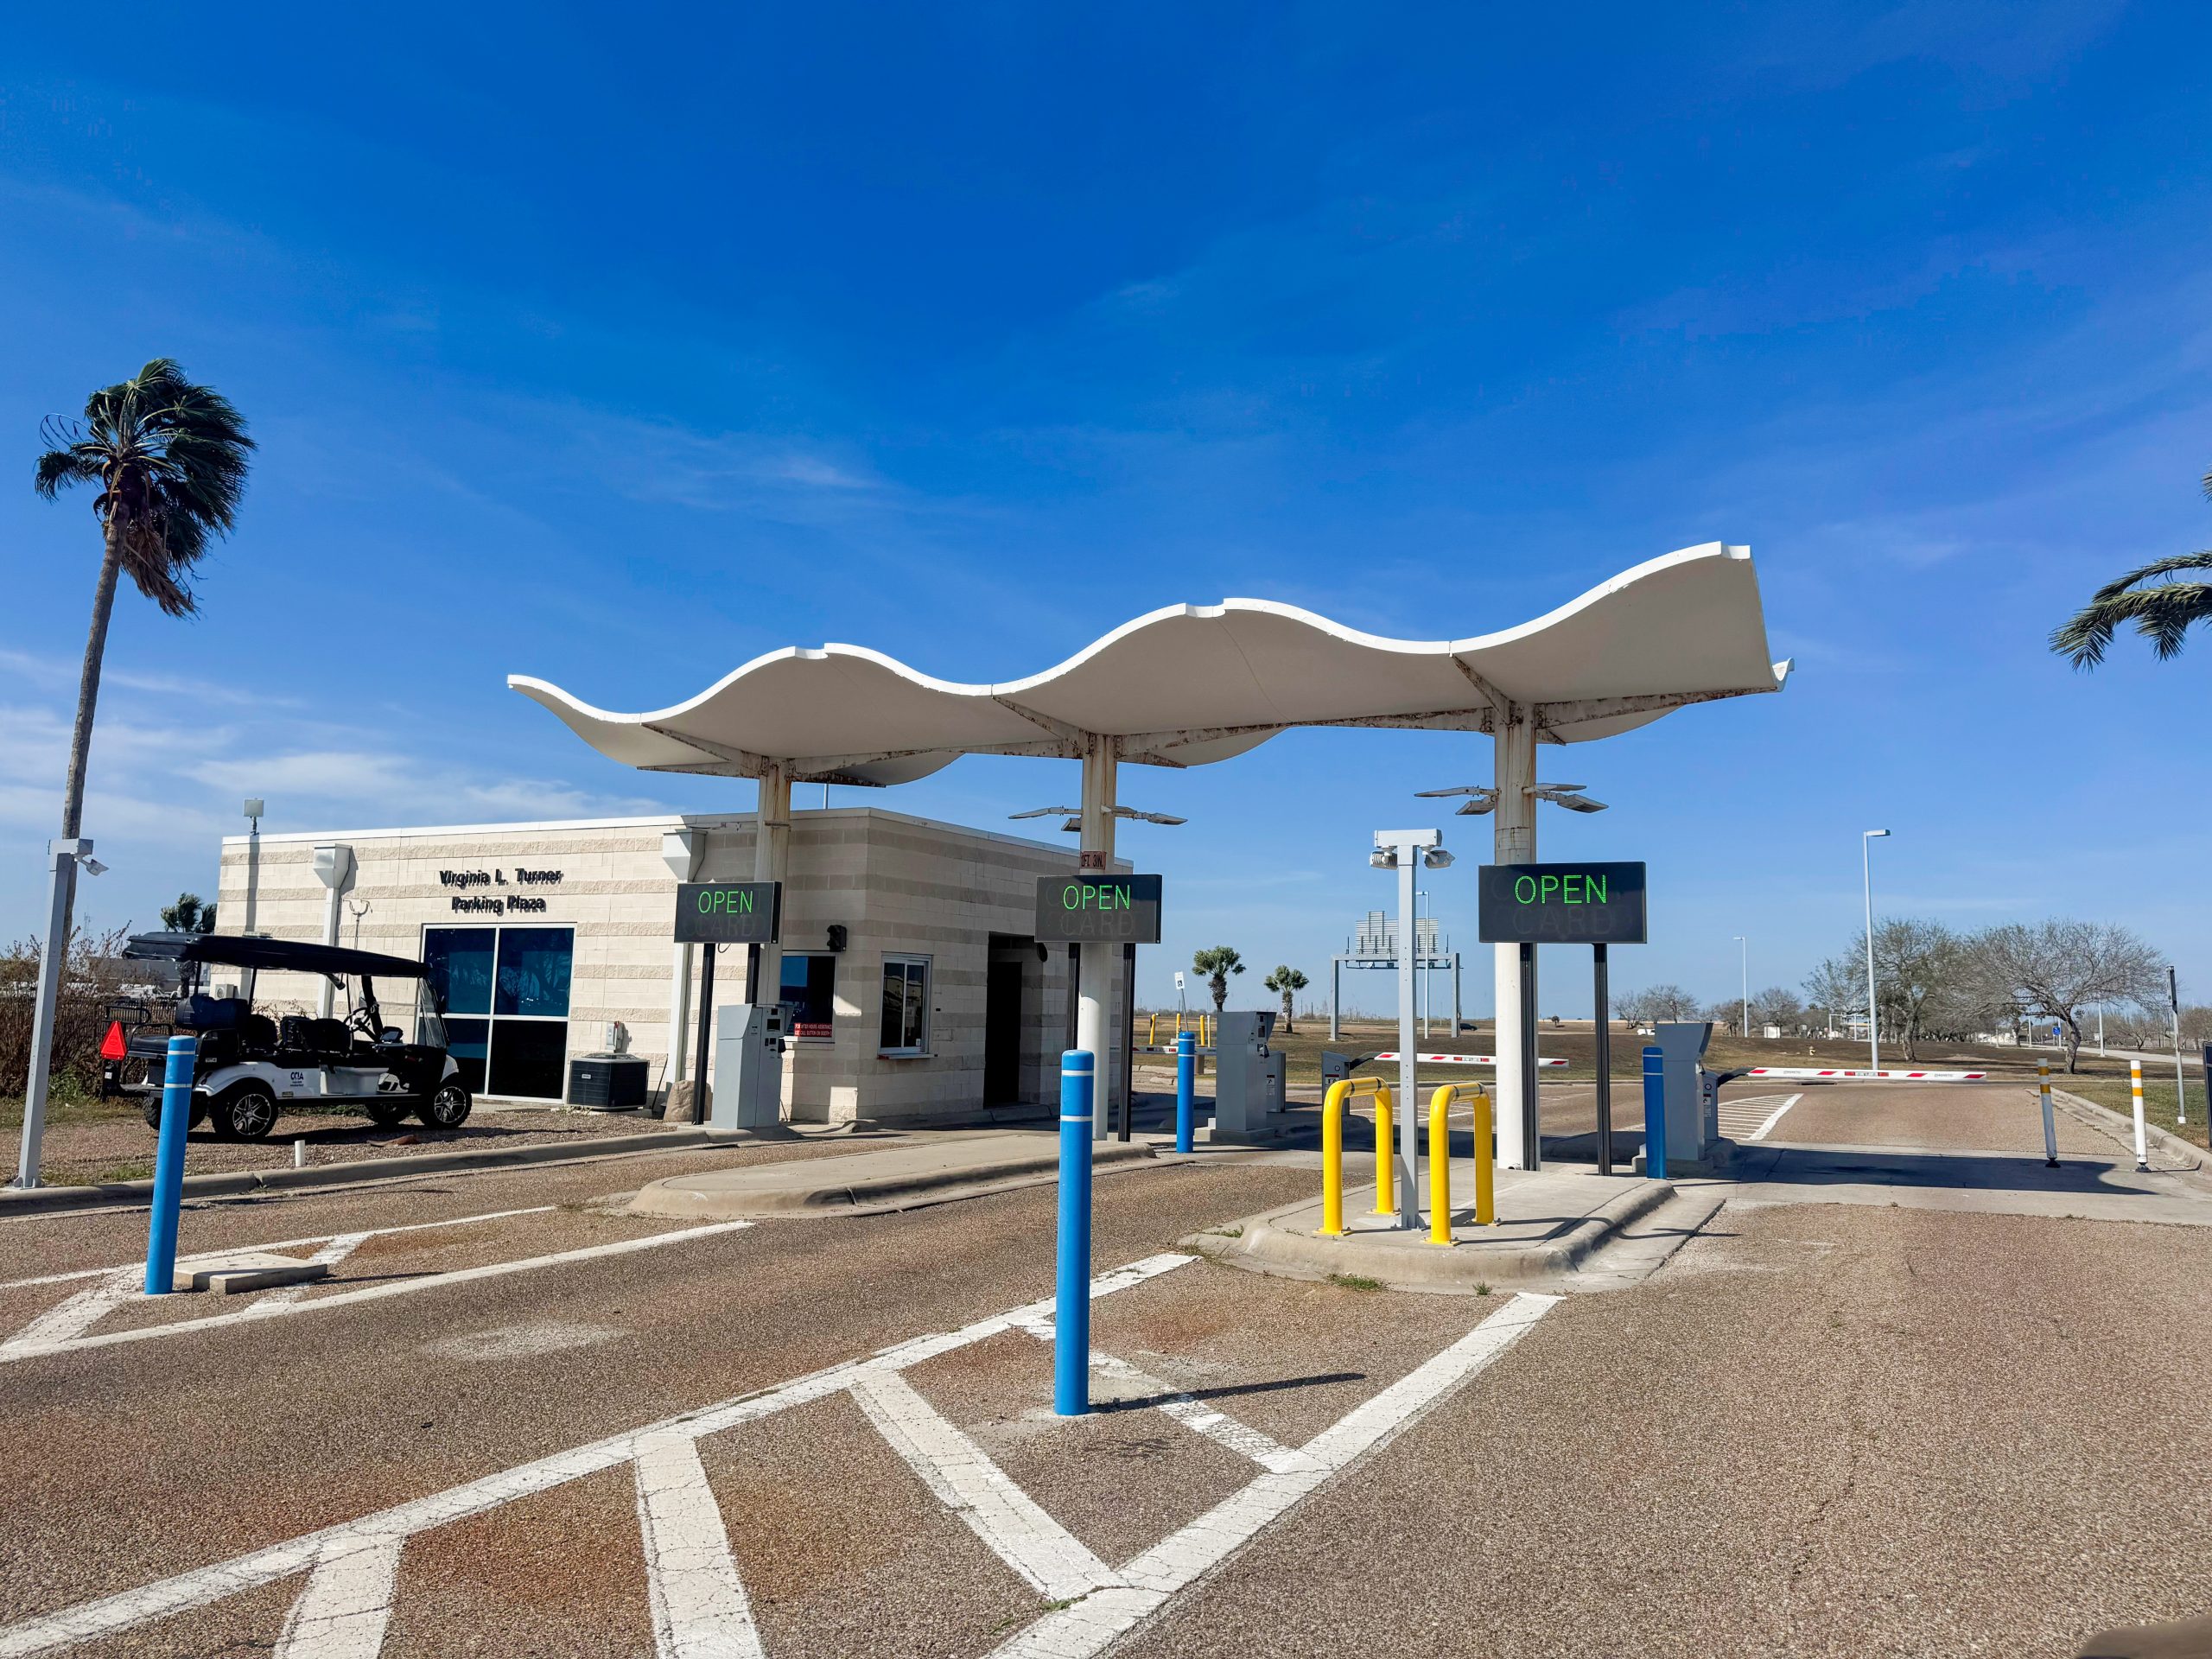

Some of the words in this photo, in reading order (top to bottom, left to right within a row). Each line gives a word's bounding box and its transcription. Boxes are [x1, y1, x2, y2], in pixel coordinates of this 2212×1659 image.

[440, 870, 489, 888] Virginia
[495, 869, 507, 884] L.
[515, 868, 563, 882] Turner
[1515, 874, 1607, 905] OPEN
[452, 896, 503, 914] Parking
[507, 895, 545, 911] Plaza
[698, 890, 753, 913] OPEN
[1063, 884, 1130, 910] OPEN
